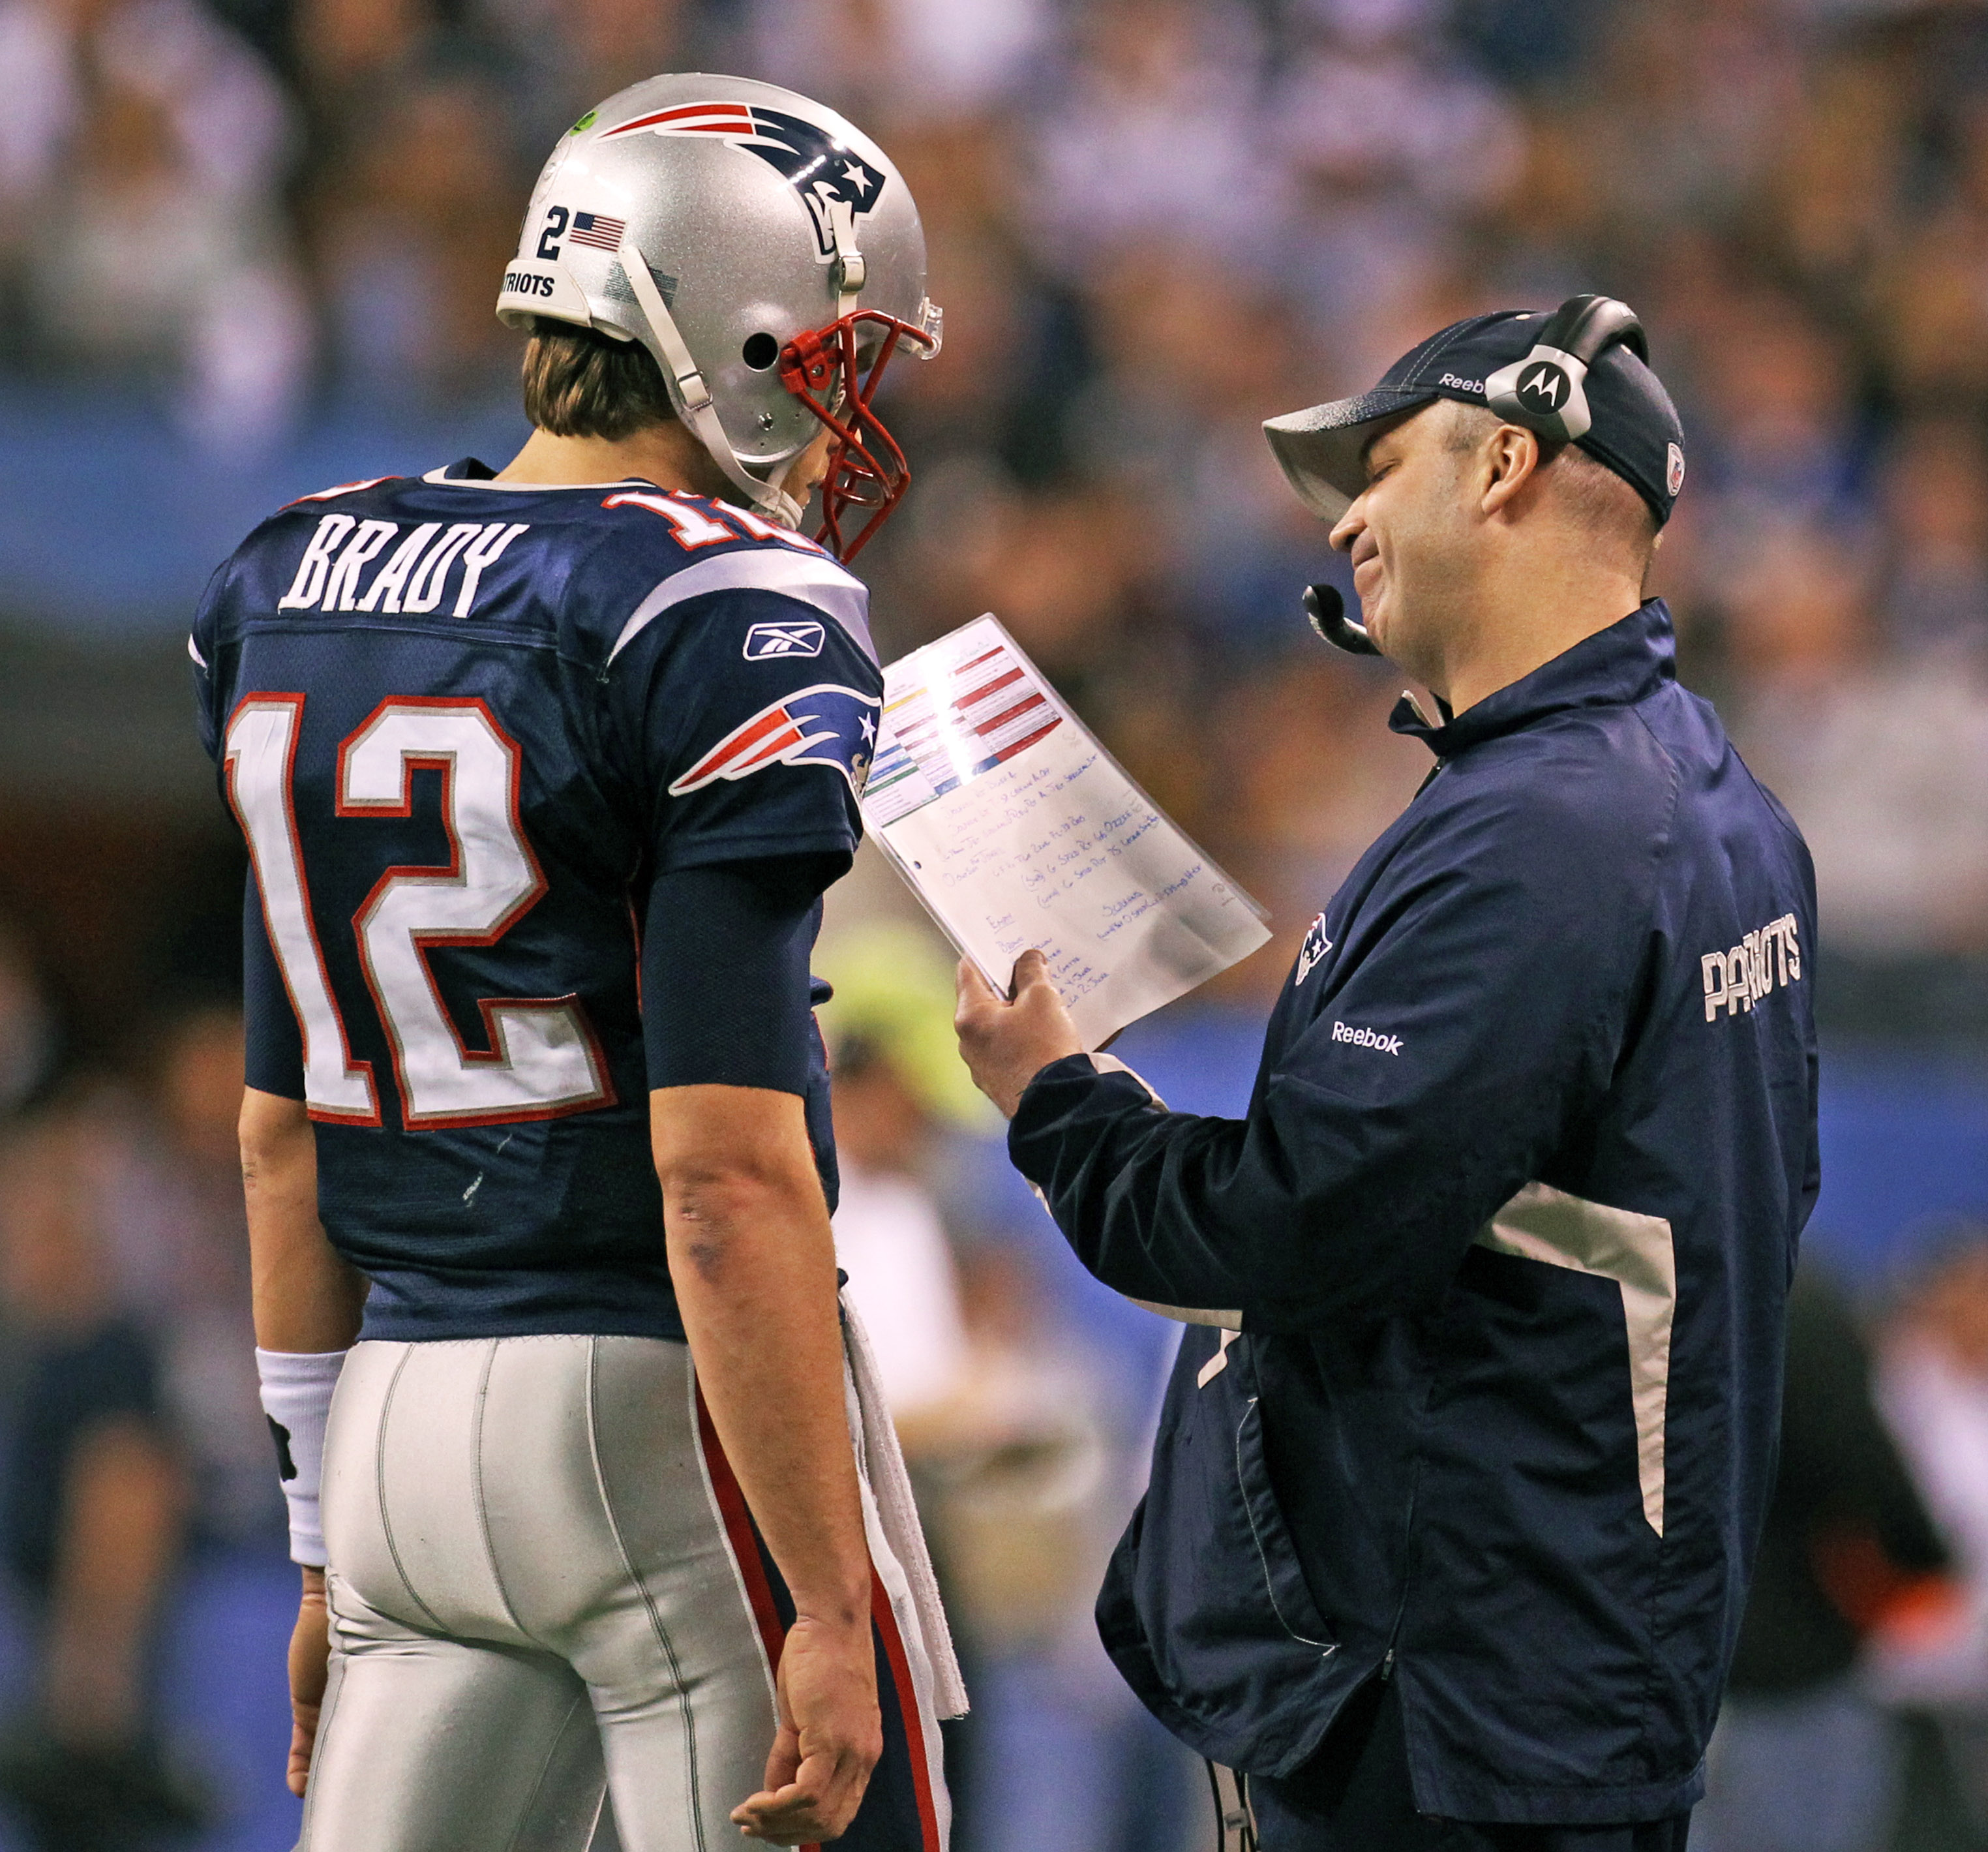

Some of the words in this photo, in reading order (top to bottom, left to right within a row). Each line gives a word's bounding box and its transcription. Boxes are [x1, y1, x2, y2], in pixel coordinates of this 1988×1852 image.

[1438, 372, 1487, 393] Reeb
[277, 513, 530, 619] BRADY
[224, 691, 620, 1132] 12
[1700, 913, 1801, 1023] PARIOTS
[1331, 1020, 1404, 1057] Reebok
